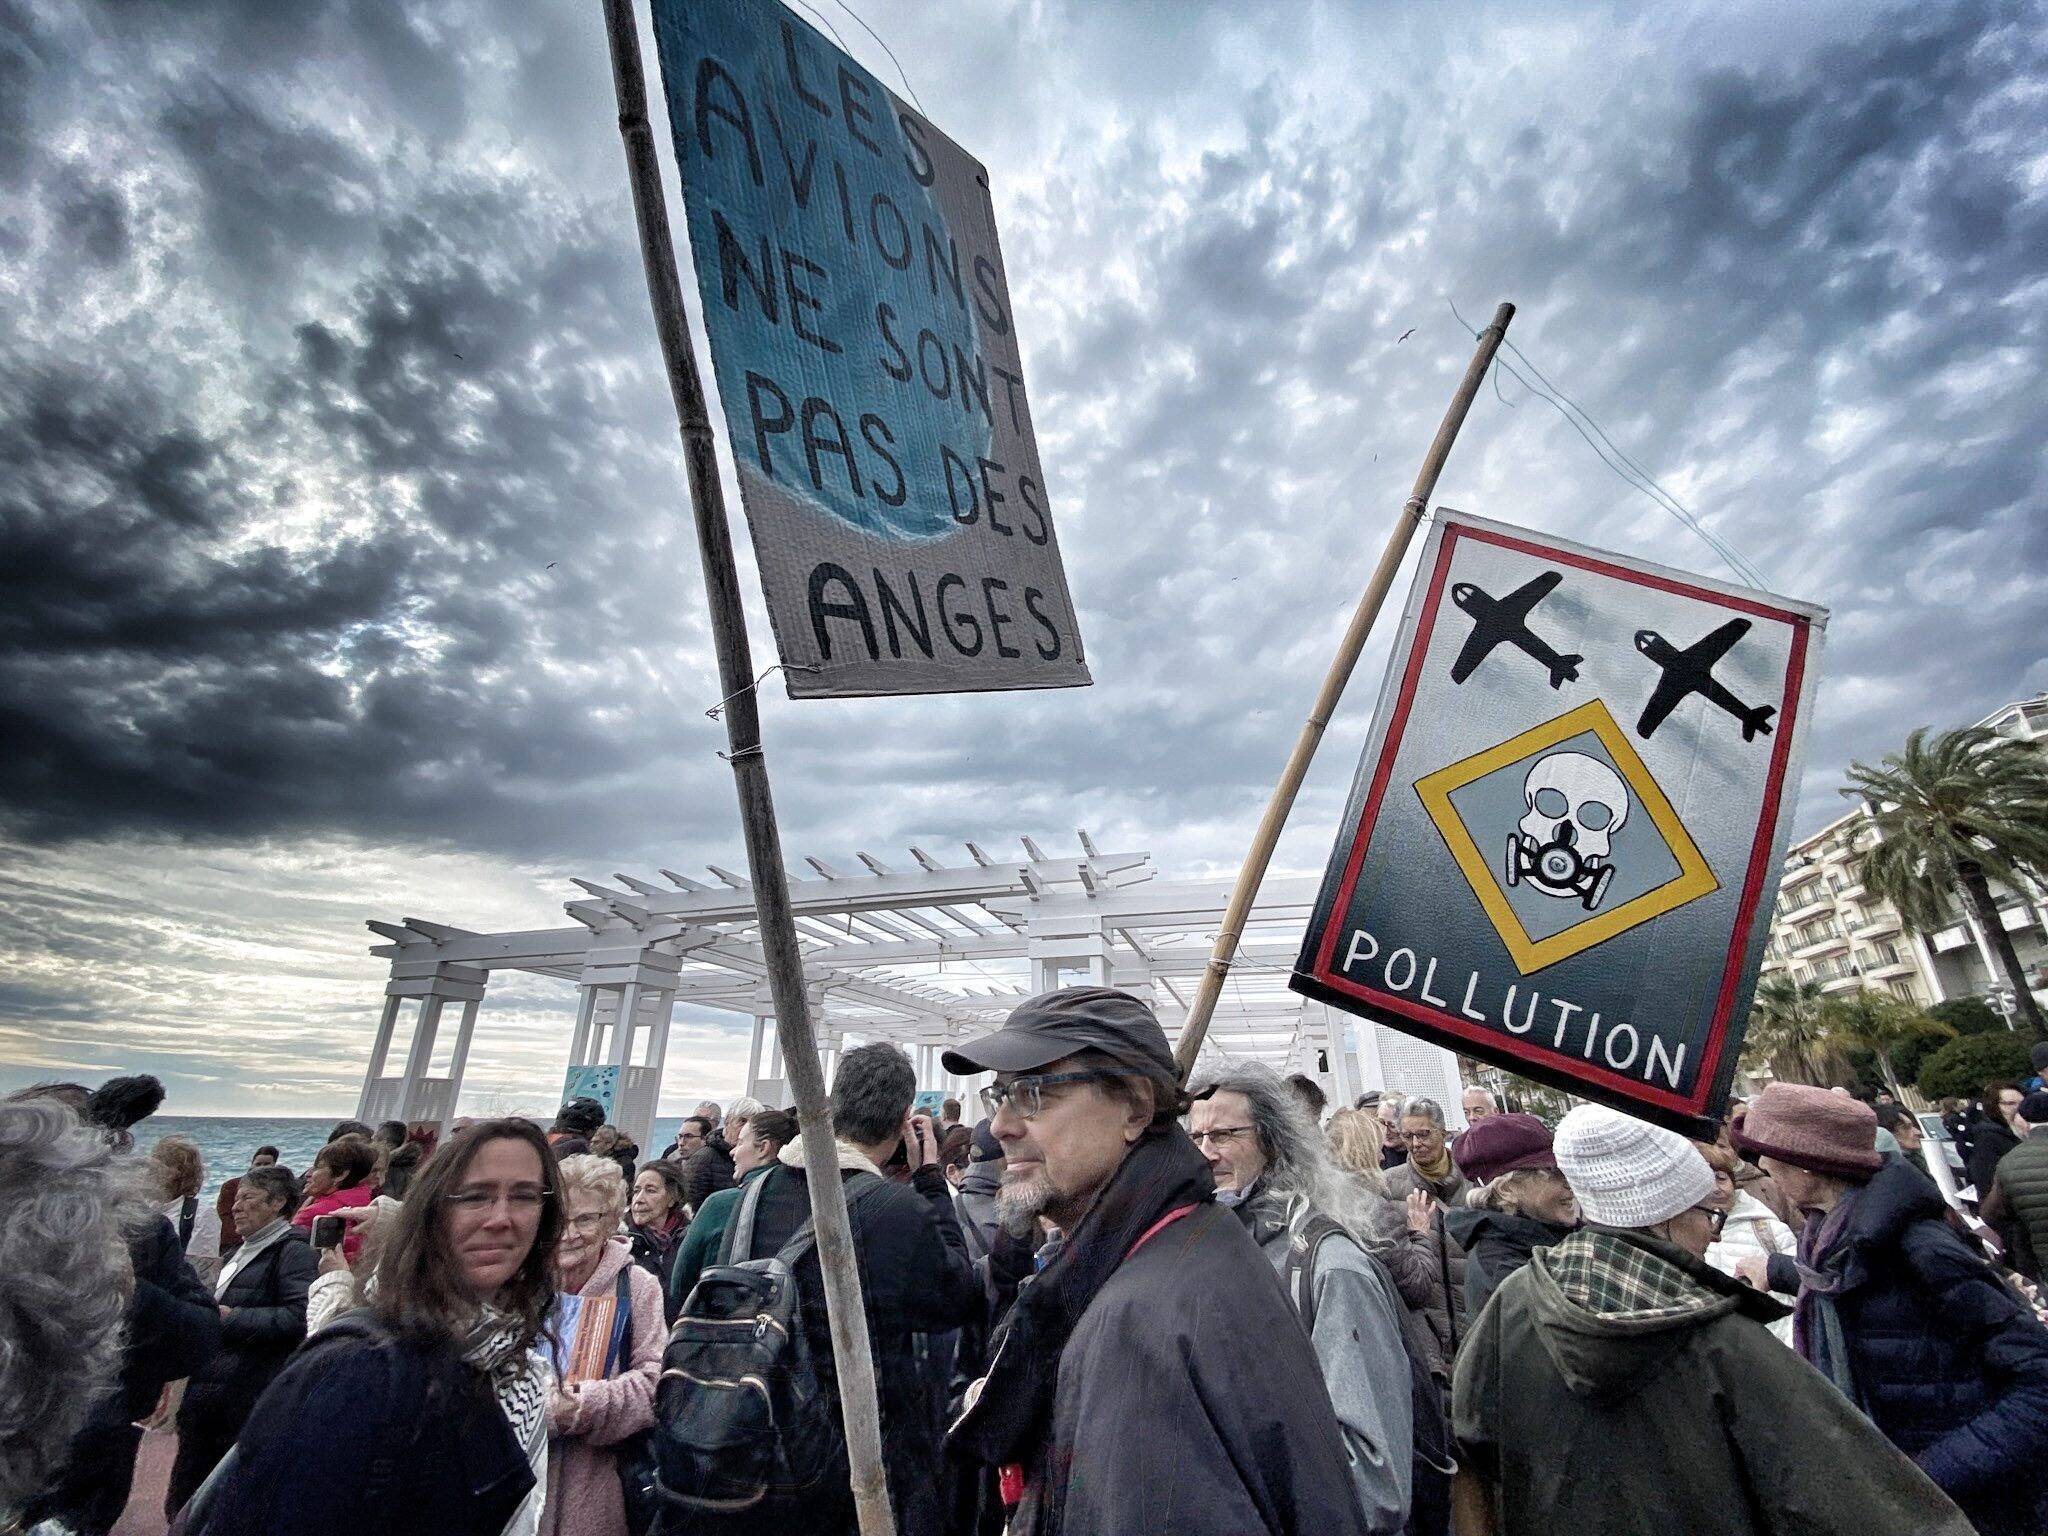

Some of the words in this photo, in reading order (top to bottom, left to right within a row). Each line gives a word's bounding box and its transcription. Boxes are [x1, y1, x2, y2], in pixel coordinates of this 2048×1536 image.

[780, 18, 936, 187] LES
[695, 57, 1010, 336] AVIONS
[711, 209, 843, 354] NE
[876, 302, 1026, 436] SONT
[745, 370, 906, 507] PAS
[940, 444, 1048, 546] DES
[808, 562, 1061, 662] ANGES
[1343, 930, 1686, 1088] POLLUTION
